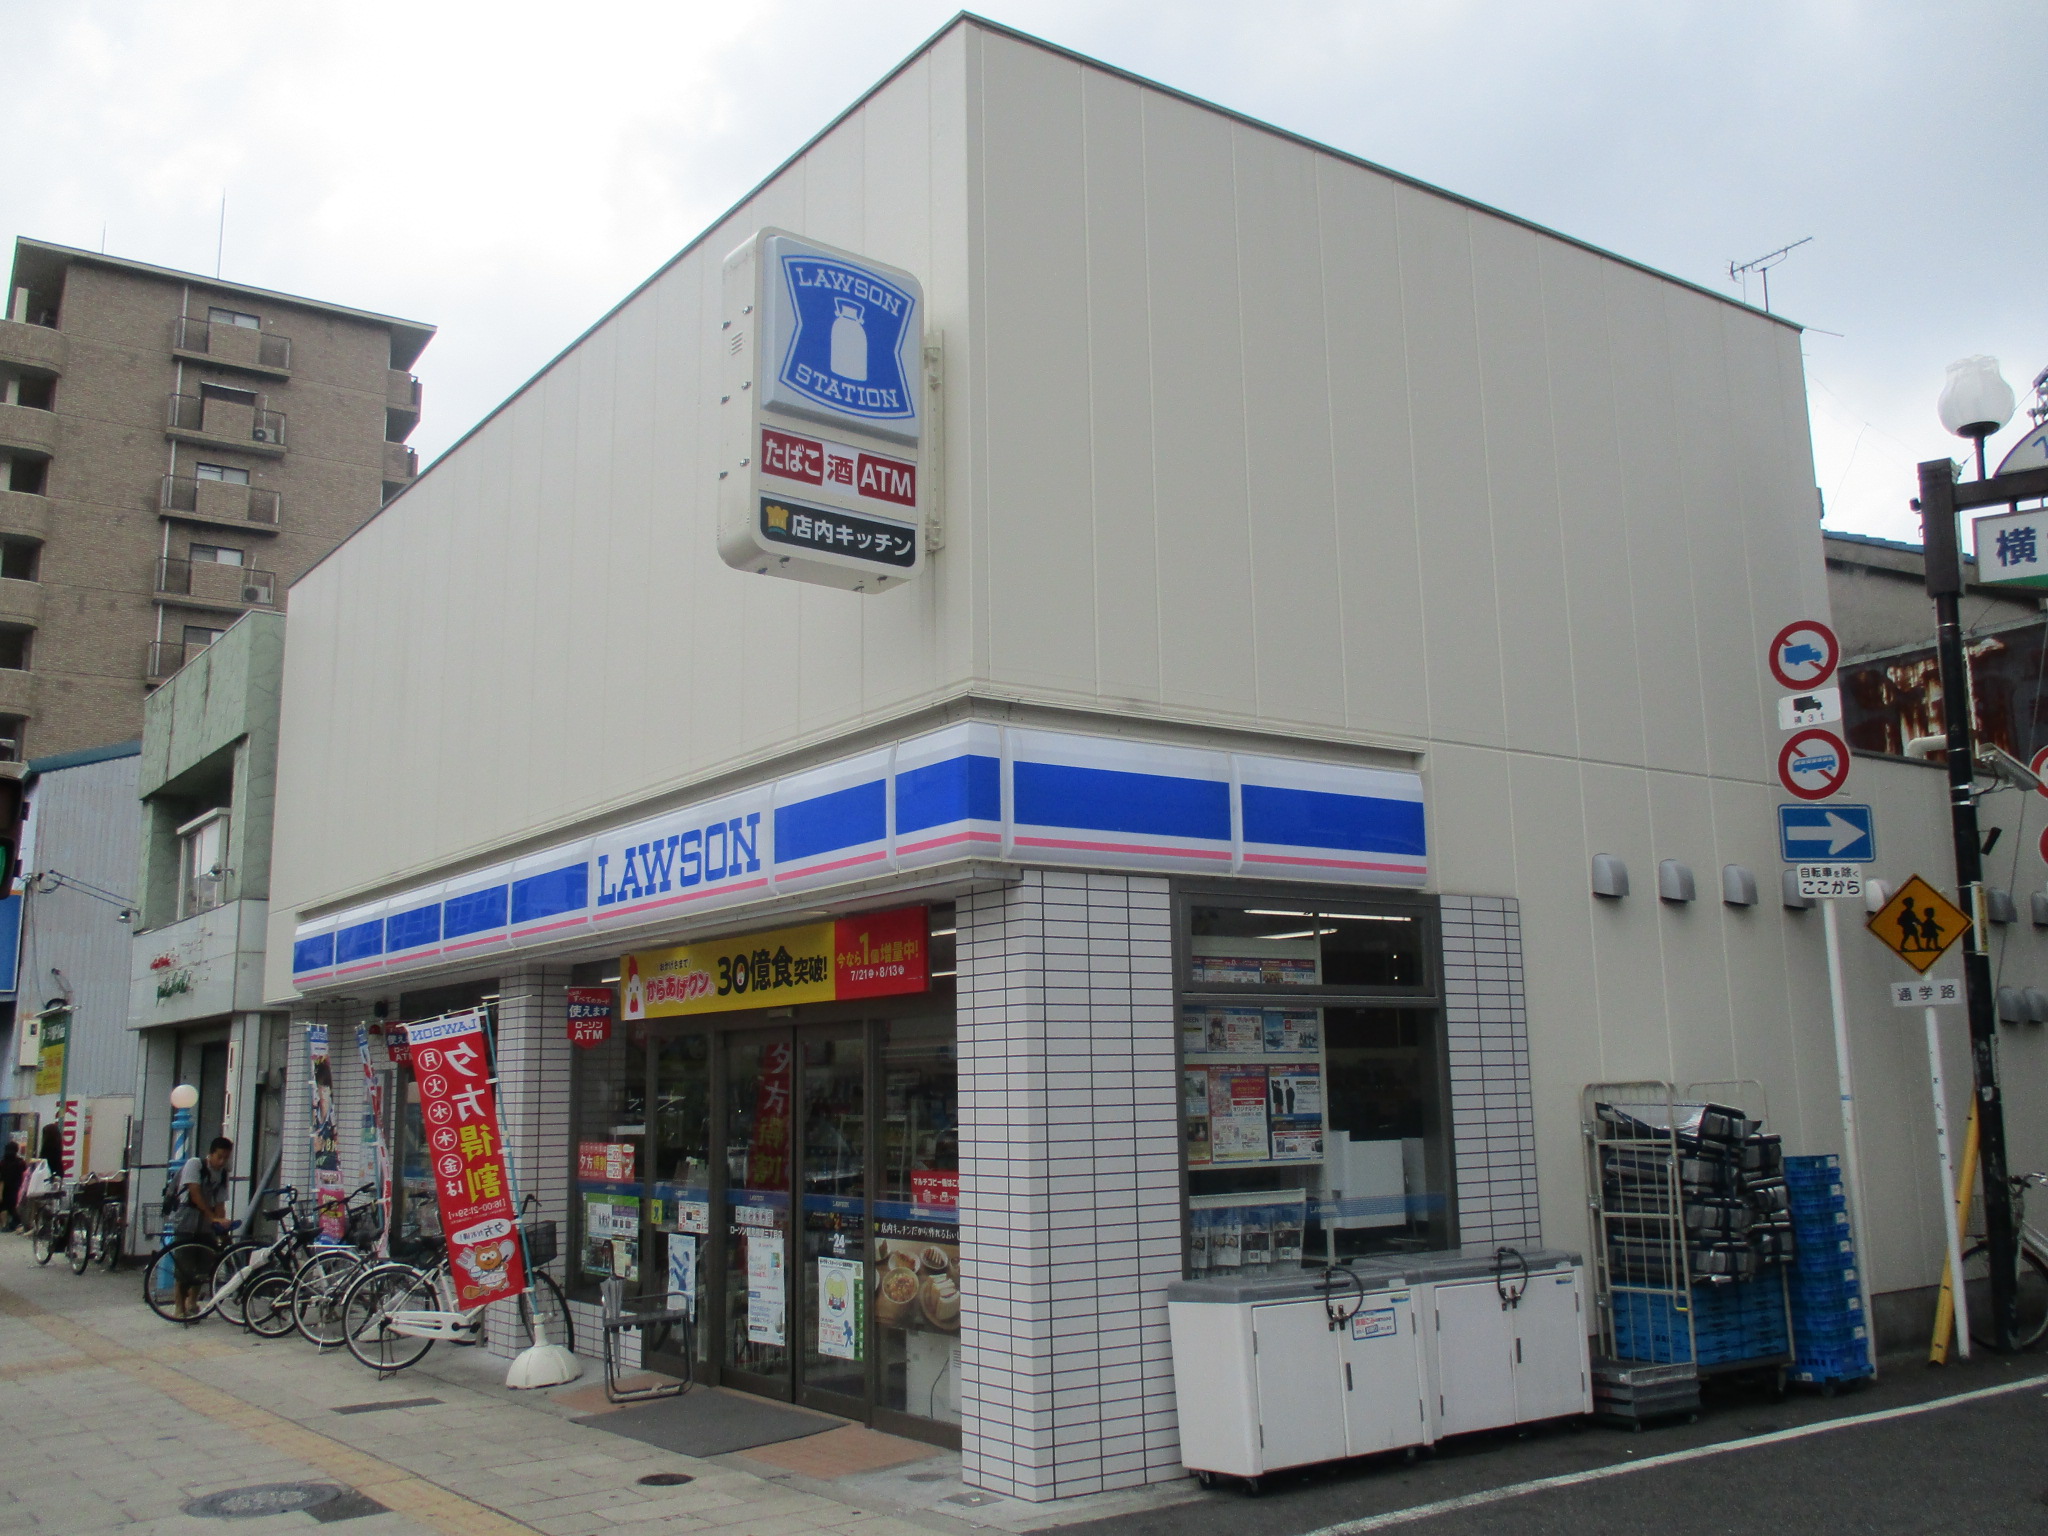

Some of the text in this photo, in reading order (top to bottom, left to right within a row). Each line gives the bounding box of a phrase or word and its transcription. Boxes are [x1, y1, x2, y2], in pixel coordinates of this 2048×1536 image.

[796, 267, 902, 317] LAWSON
[796, 363, 900, 407] STATION
[765, 437, 912, 498] たばこ 酒 ATM
[792, 513, 912, 557] 店内キッチン
[597, 811, 761, 907] LAWSON
[1801, 867, 1859, 878] 自転車を除く
[1802, 880, 1860, 895] ここから
[1898, 985, 1955, 1001] 通学路
[569, 1005, 610, 1018] 使えます
[575, 1021, 603, 1029] ローソン
[574, 1029, 603, 1040] ATM
